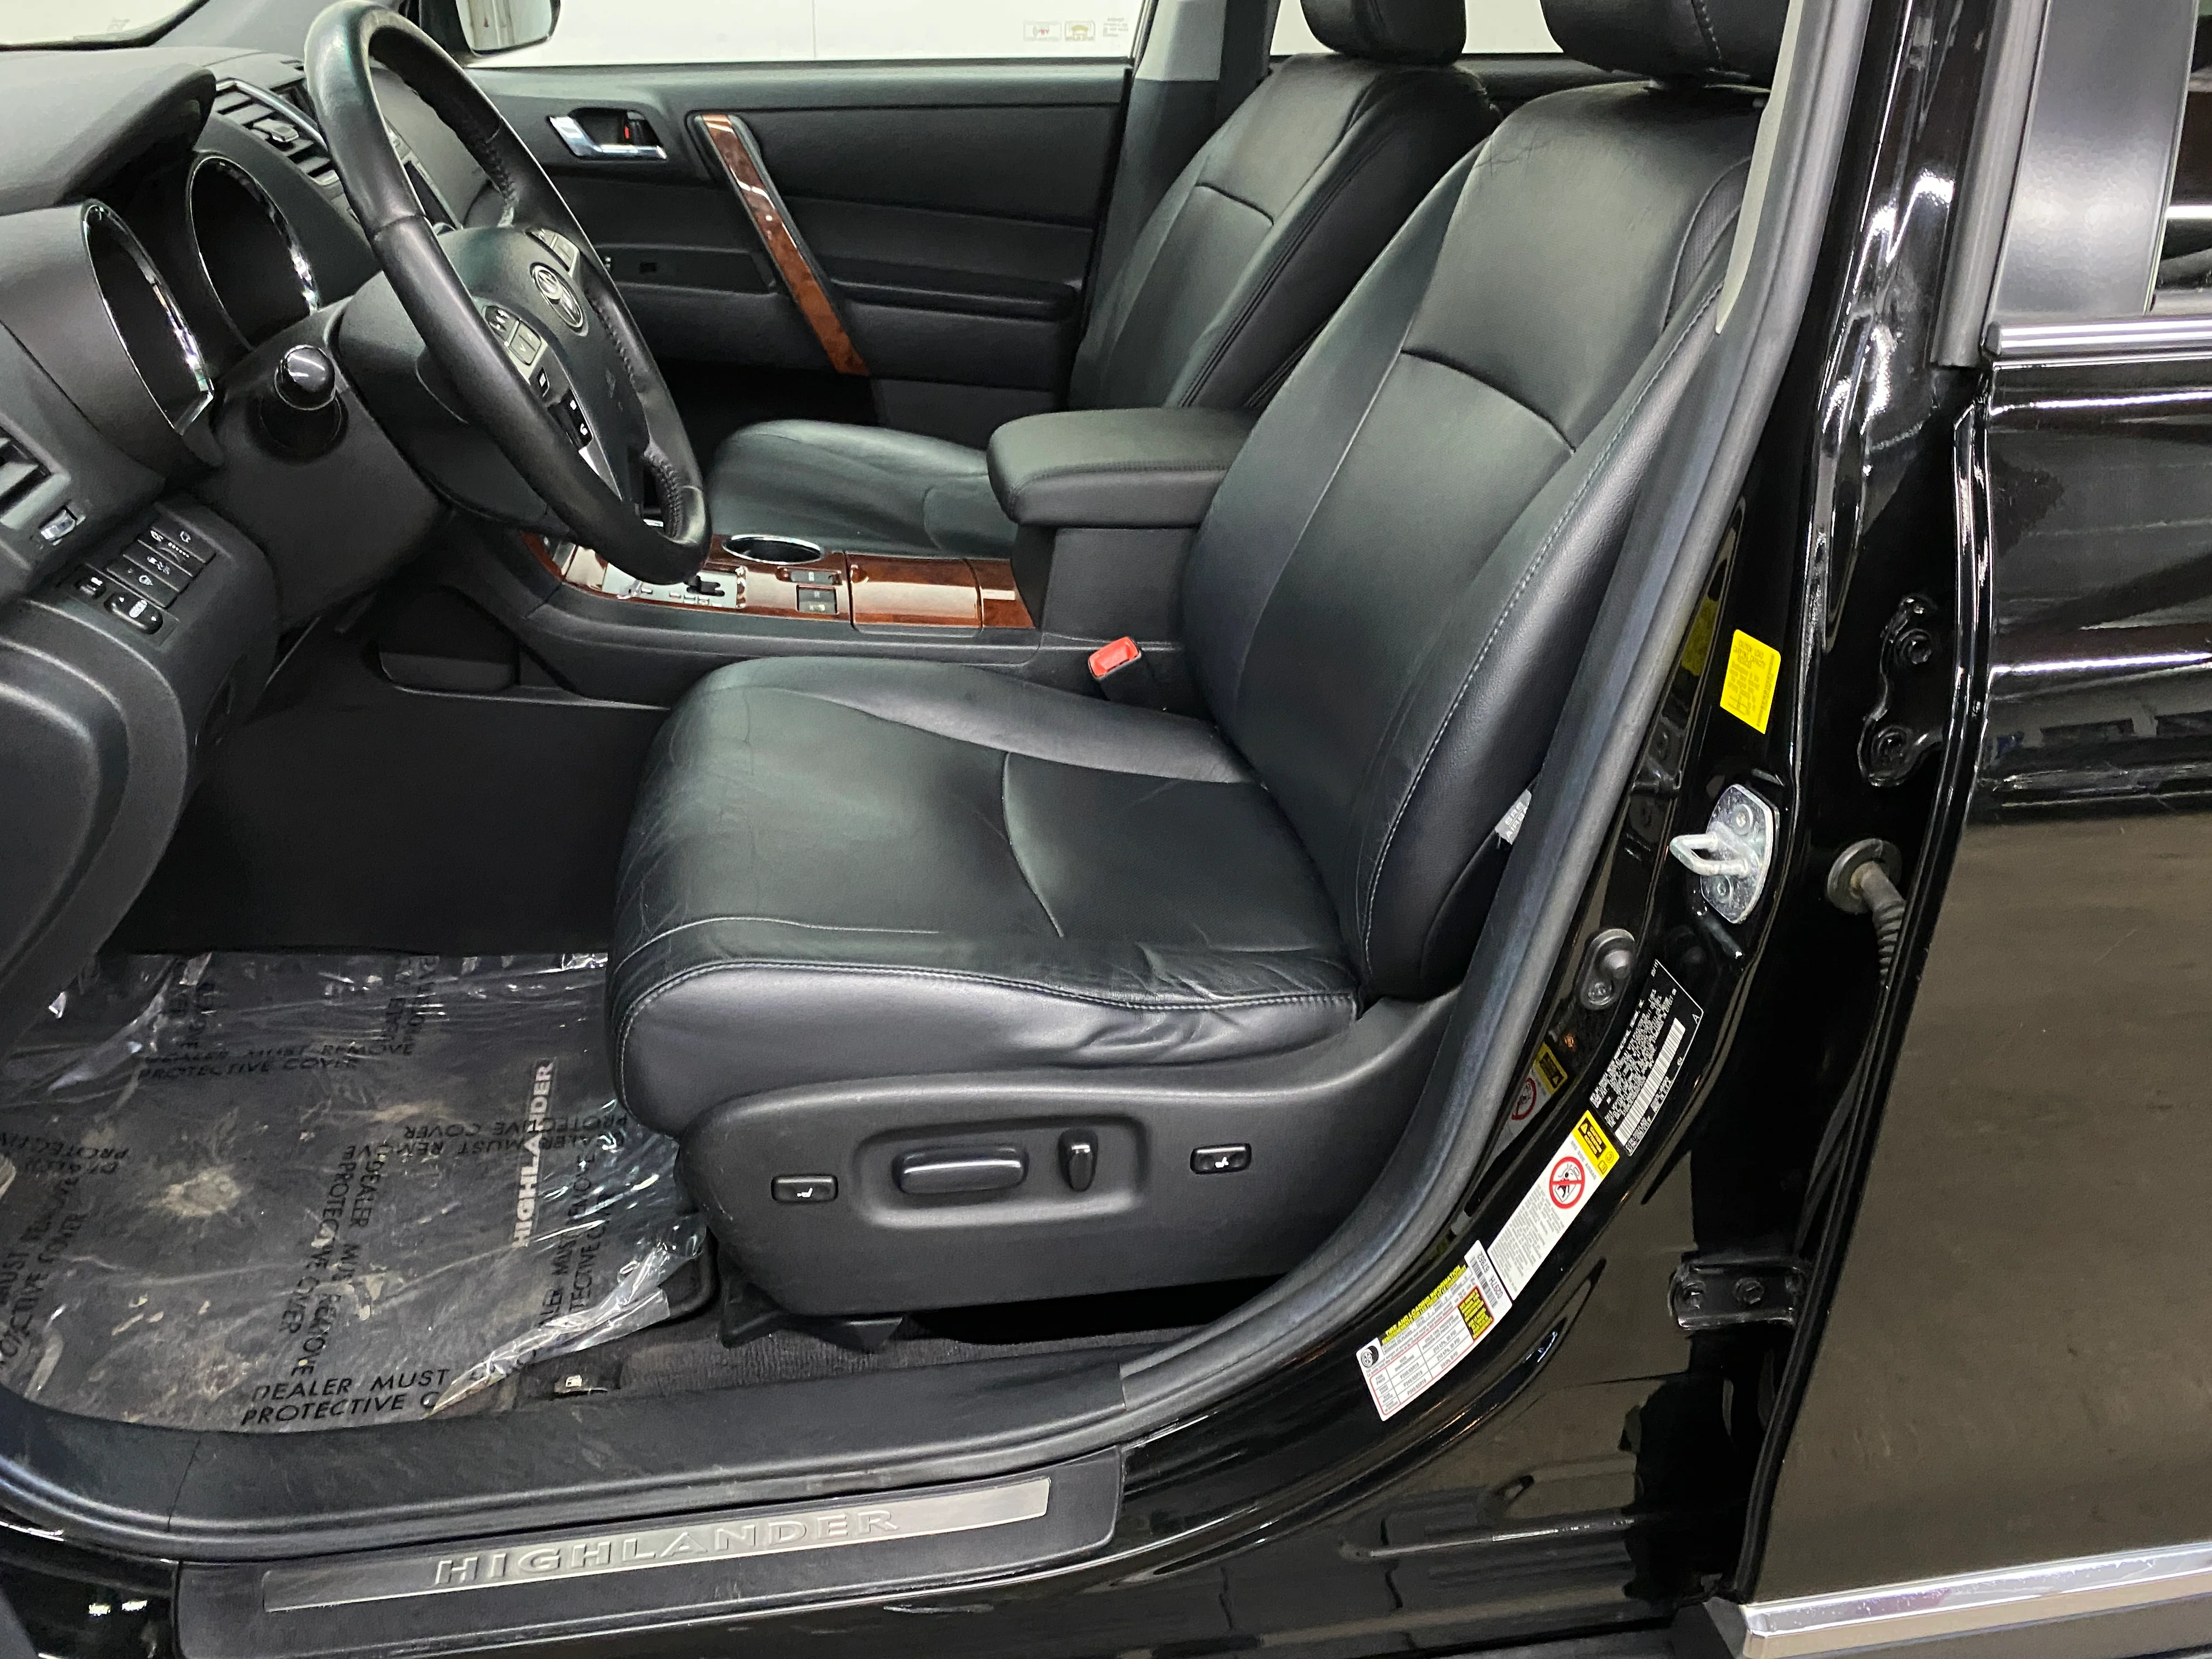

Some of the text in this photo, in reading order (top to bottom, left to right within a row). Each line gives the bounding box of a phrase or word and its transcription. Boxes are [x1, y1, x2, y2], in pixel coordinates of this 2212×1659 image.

[1505, 802, 1523, 825] SRS
[1506, 807, 1527, 838] AIRBA
[1692, 1012, 1700, 1023] A
[137, 1059, 272, 1080] PROTECTIVE
[404, 1113, 628, 1139] PROTECTIVE COVER
[456, 1136, 526, 1156] MUST
[511, 1061, 555, 1249] HIGHLANDER
[1577, 1150, 1585, 1162] SIDE
[1584, 1163, 1596, 1180] AIRBAG
[349, 1160, 385, 1228] DEALER
[330, 1241, 360, 1286] MUS
[569, 1241, 600, 1313] TECTIVE
[1385, 1323, 1398, 1336] TIRE
[1397, 1313, 1409, 1327] AND
[1408, 1295, 1431, 1317] LOADING
[1429, 1265, 1461, 1299] INFORMATION
[251, 1369, 450, 1403] DEALER MUST
[240, 1392, 408, 1426] PROTECTIVE
[433, 1509, 899, 1585] HIGHLANDER
